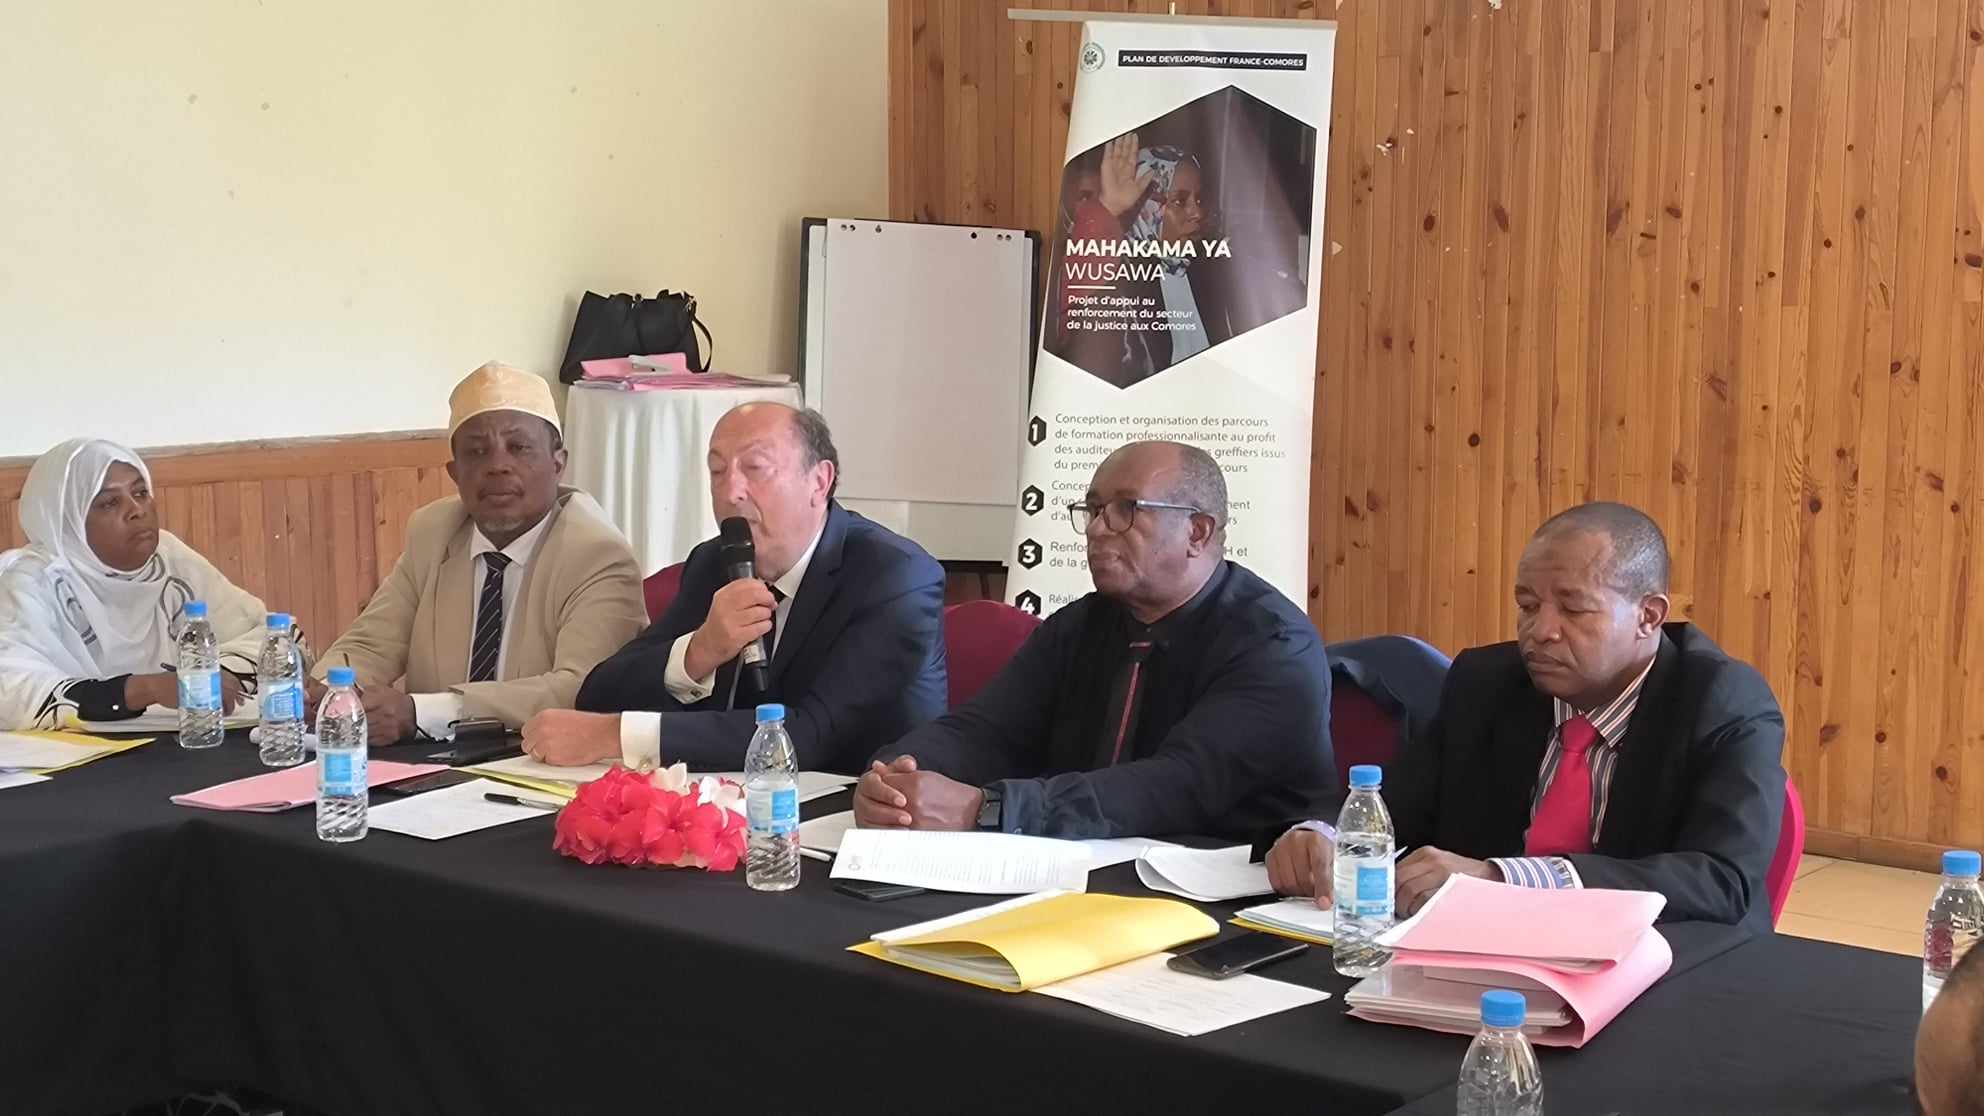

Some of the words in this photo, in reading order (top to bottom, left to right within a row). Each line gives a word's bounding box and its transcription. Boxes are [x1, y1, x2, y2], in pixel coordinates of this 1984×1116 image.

[1159, 55, 1228, 64] DEVELOPPEMENT
[1229, 56, 1304, 66] FRANCE-COMORES
[1066, 239, 1197, 258] MAHAKAMA
[1202, 240, 1232, 258] YA
[1065, 262, 1166, 281] WUSAWA
[1068, 295, 1098, 306] Projet
[1100, 296, 1140, 308] d'appui
[1142, 298, 1156, 306] au
[1067, 308, 1137, 318] renforcement
[1139, 309, 1154, 318] du
[1156, 310, 1193, 318] secteur
[1066, 320, 1081, 330] de
[1083, 320, 1092, 330] la
[1094, 320, 1128, 332] justice
[1130, 322, 1149, 330] aux
[1151, 321, 1197, 331] Comores
[1055, 413, 1117, 426] Conception
[1120, 415, 1130, 424] et
[1132, 415, 1198, 428] organisation
[1200, 416, 1220, 426] des
[1222, 417, 1269, 428] parcours
[1031, 423, 1039, 442] 1
[1054, 428, 1068, 439] de
[1071, 428, 1124, 440] formation
[1126, 430, 1228, 442] professionnalisante
[1230, 432, 1244, 442] au
[1246, 431, 1277, 443] profit
[1054, 444, 1073, 454] des
[1214, 446, 1259, 459] greffiers
[1261, 448, 1287, 458] issus
[1054, 460, 1068, 470] du
[1070, 461, 1100, 471] prem
[1220, 464, 1248, 473] cours
[1050, 480, 1090, 492] Concep
[1025, 492, 1038, 511] 2
[1022, 545, 1036, 564] 3
[1236, 546, 1248, 557] et
[1049, 556, 1064, 568] de
[1066, 556, 1078, 568] la
[1020, 596, 1035, 614] 4
